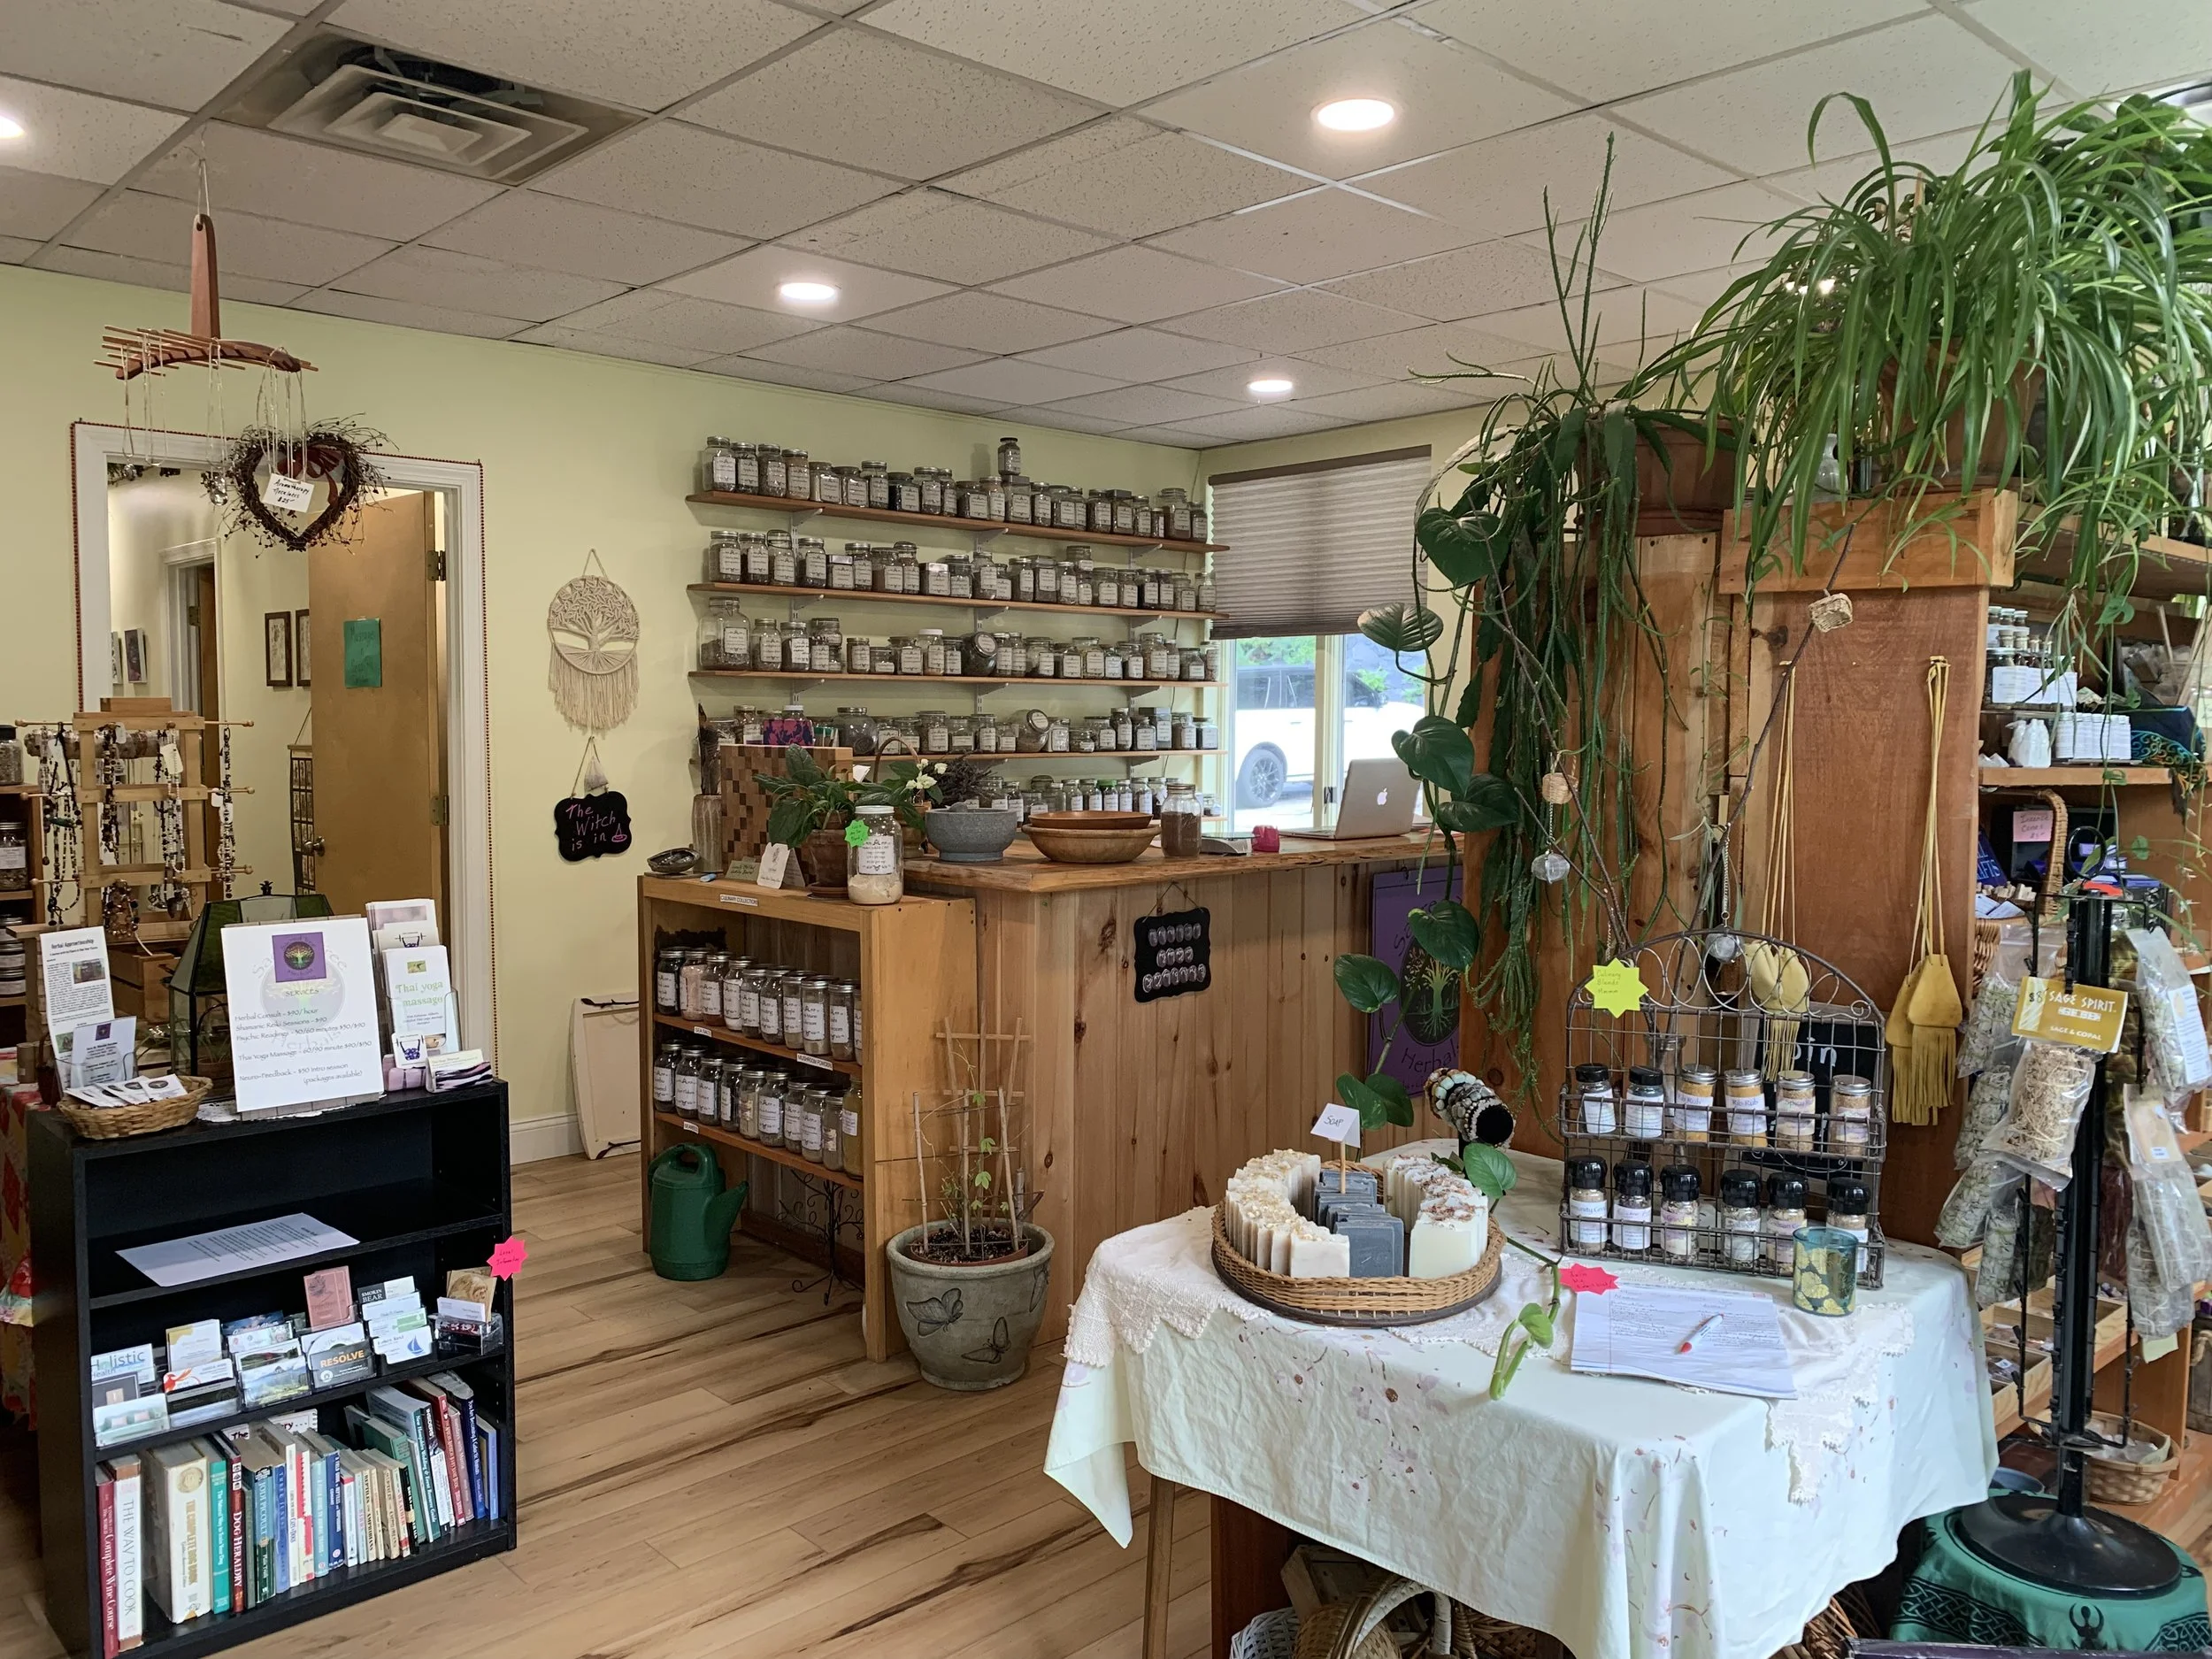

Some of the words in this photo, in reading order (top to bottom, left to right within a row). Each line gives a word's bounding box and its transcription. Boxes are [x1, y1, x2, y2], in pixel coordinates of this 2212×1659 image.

[565, 803, 593, 819] The
[576, 810, 616, 835] Witch
[572, 838, 582, 851] is
[594, 833, 607, 843] in
[285, 988, 319, 997] SERVICES
[396, 983, 419, 995] Thai
[422, 981, 443, 996] yoga
[403, 996, 443, 1008] massage
[2049, 991, 2078, 1005] SAGE
[2081, 996, 2116, 1012] SPIRIT
[261, 1031, 289, 1041] Readings
[361, 1288, 382, 1297] SMOKIN
[362, 1294, 383, 1303] BEAR
[320, 1349, 365, 1368] RESOLVE
[123, 1500, 134, 1524] THE
[233, 1511, 242, 1532] DOG
[124, 1526, 134, 1553] WAY
[102, 1533, 114, 1575] Complete
[124, 1554, 135, 1571] TO
[233, 1532, 242, 1586] HERALDRY
[105, 1574, 117, 1600] Wine
[124, 1572, 135, 1615] COOK
[105, 1601, 117, 1630] Course
